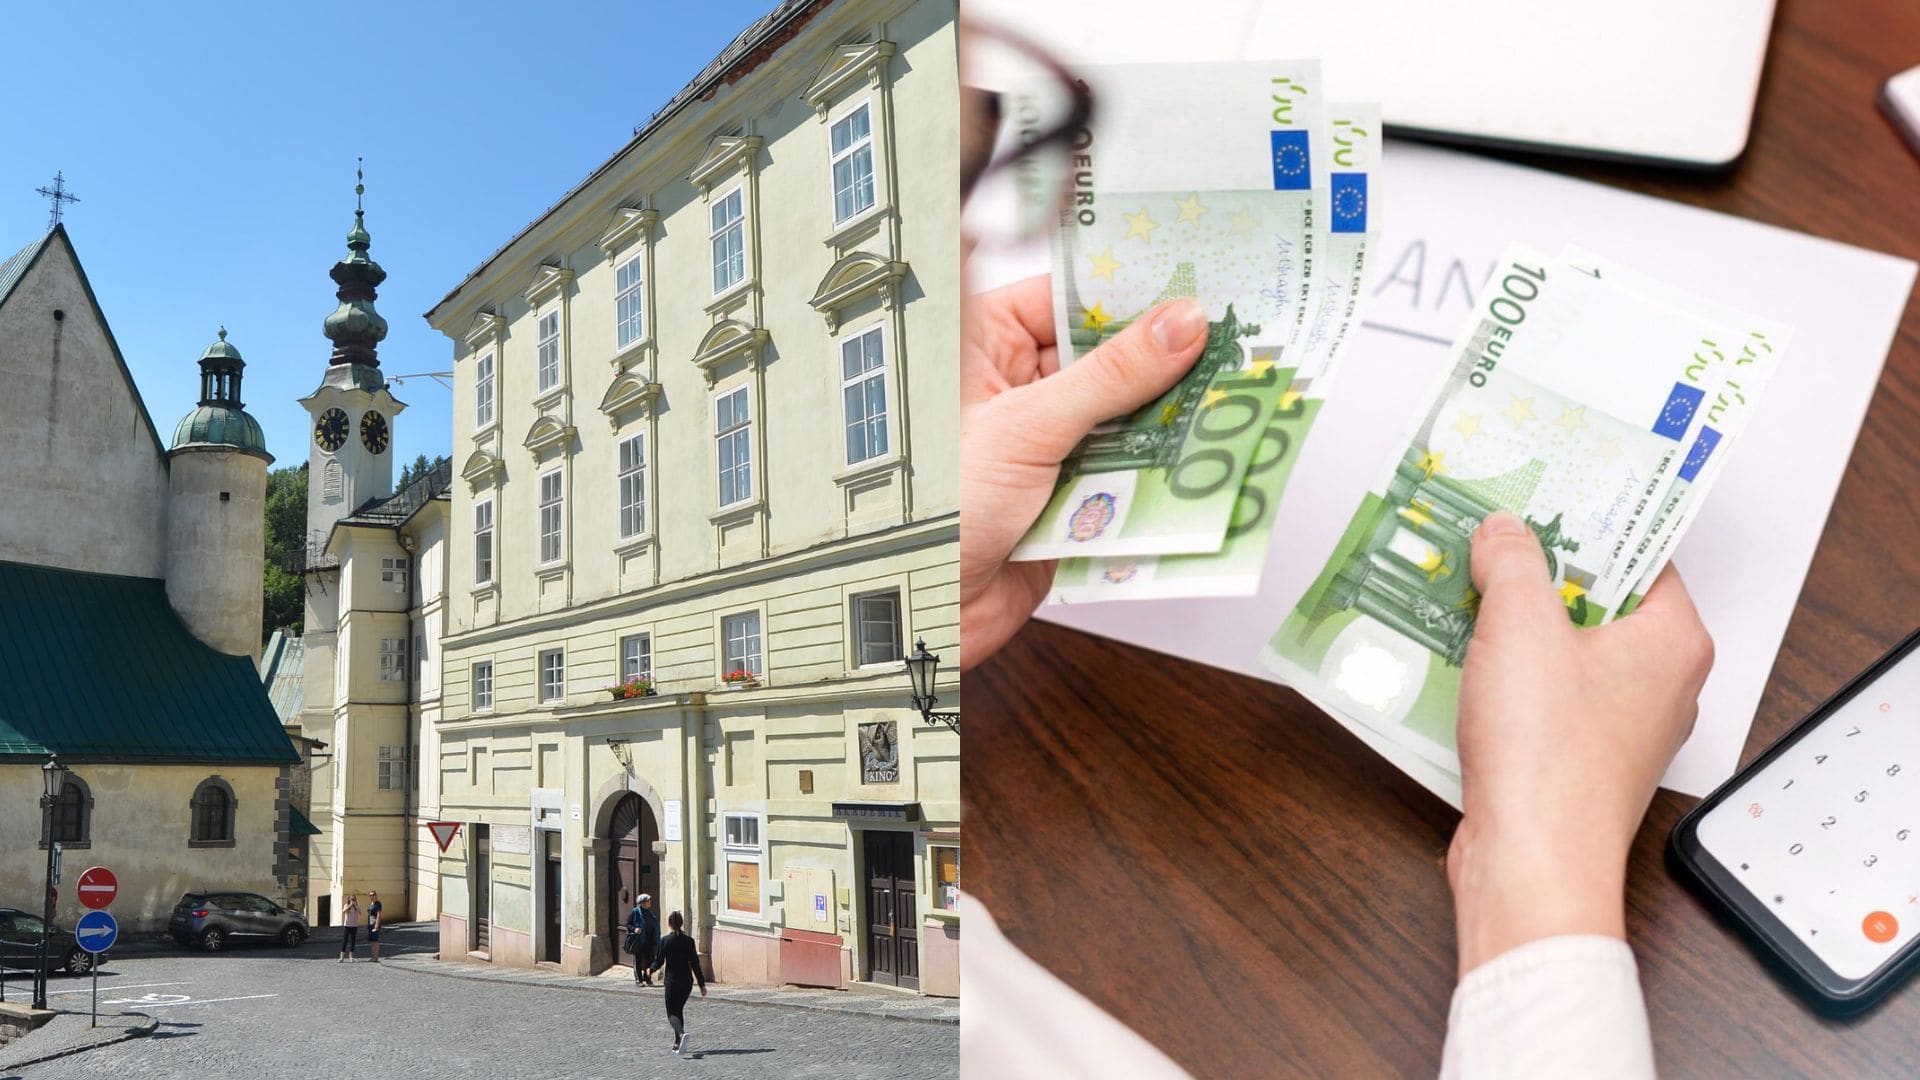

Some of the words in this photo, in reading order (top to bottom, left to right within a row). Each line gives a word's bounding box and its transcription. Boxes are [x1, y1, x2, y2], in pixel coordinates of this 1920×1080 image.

[1073, 154, 1096, 226] EURO
[1303, 209, 1313, 228] BCE
[1304, 234, 1312, 254] ECB
[1490, 262, 1546, 325] 100
[1469, 326, 1513, 388] EURO
[1170, 365, 1277, 499] 100
[1846, 725, 1862, 738] 7
[1814, 753, 1829, 765] 4
[869, 769, 893, 782] KINO
[1886, 763, 1901, 777] 8
[1782, 778, 1795, 790] 1
[1854, 790, 1870, 804] 5
[1821, 816, 1837, 830] 2
[1896, 828, 1911, 841] 6
[1788, 843, 1804, 856] 0
[1863, 854, 1878, 868] 3
